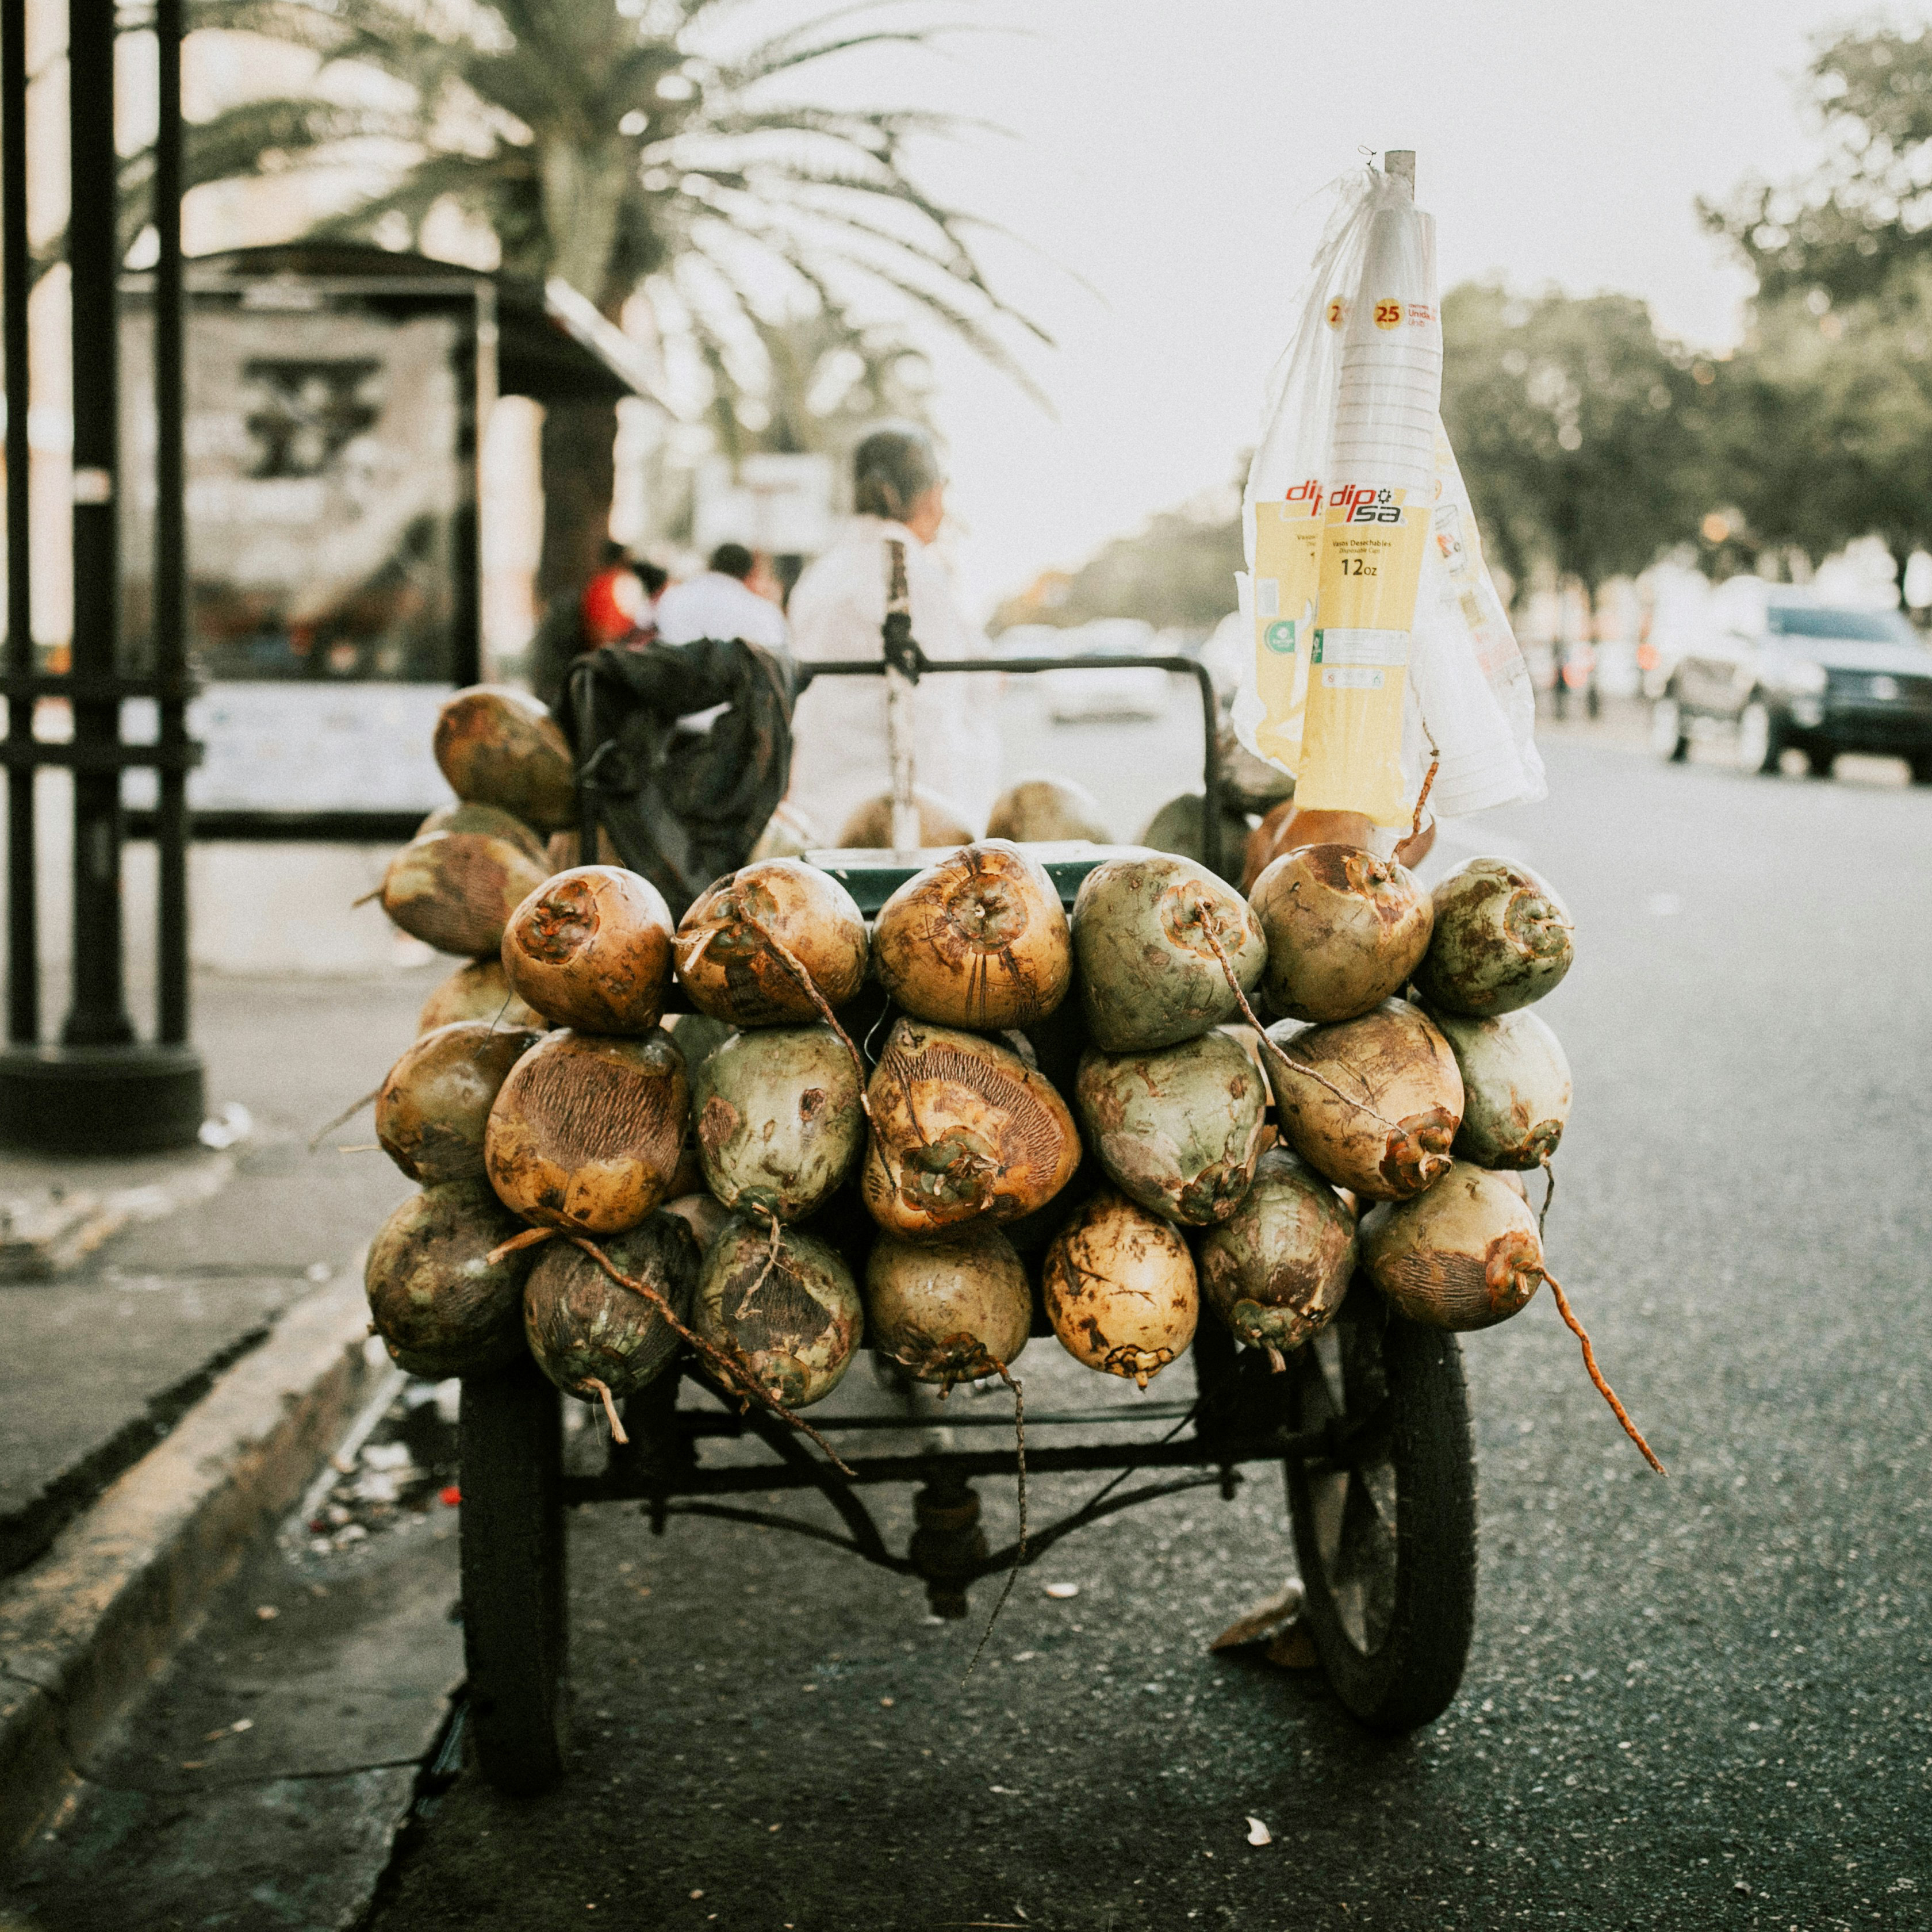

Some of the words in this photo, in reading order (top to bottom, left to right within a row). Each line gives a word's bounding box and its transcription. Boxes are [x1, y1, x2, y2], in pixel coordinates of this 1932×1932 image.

[1377, 306, 1400, 323] 25
[1329, 484, 1377, 523] dip
[1354, 505, 1401, 523] sa
[1341, 558, 1378, 576] 12oz
